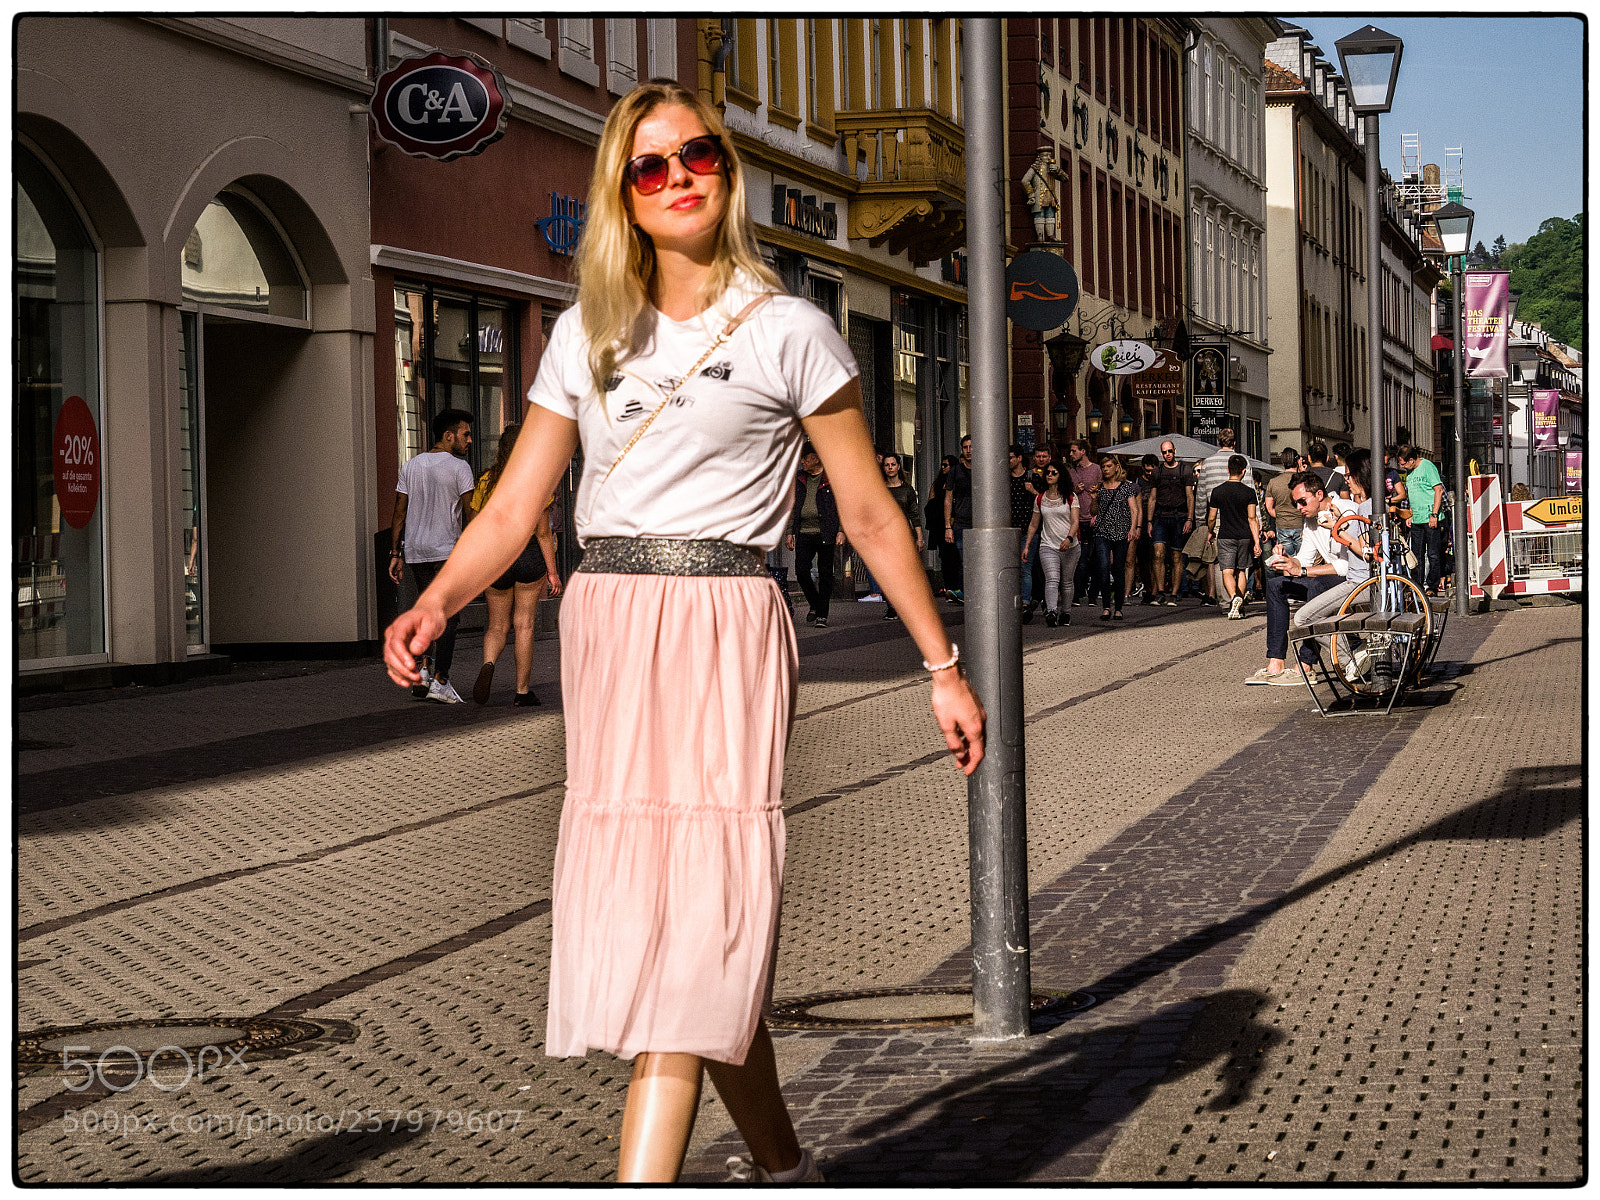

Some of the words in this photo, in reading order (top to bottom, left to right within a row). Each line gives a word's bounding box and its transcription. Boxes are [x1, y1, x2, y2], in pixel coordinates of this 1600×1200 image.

[397, 82, 478, 125] C&A
[1467, 309, 1483, 317] DAS
[1467, 316, 1504, 325] THEATER
[1467, 324, 1504, 333] FESTIVAL
[1134, 372, 1181, 382] PERKEO
[1195, 397, 1223, 406] PERKEO
[1199, 417, 1217, 426] Hotel
[60, 434, 94, 465] -20%
[62, 470, 70, 481] auf
[76, 471, 93, 482] gesamte
[67, 482, 88, 494] Kollektion
[1549, 501, 1581, 516] Umlei
